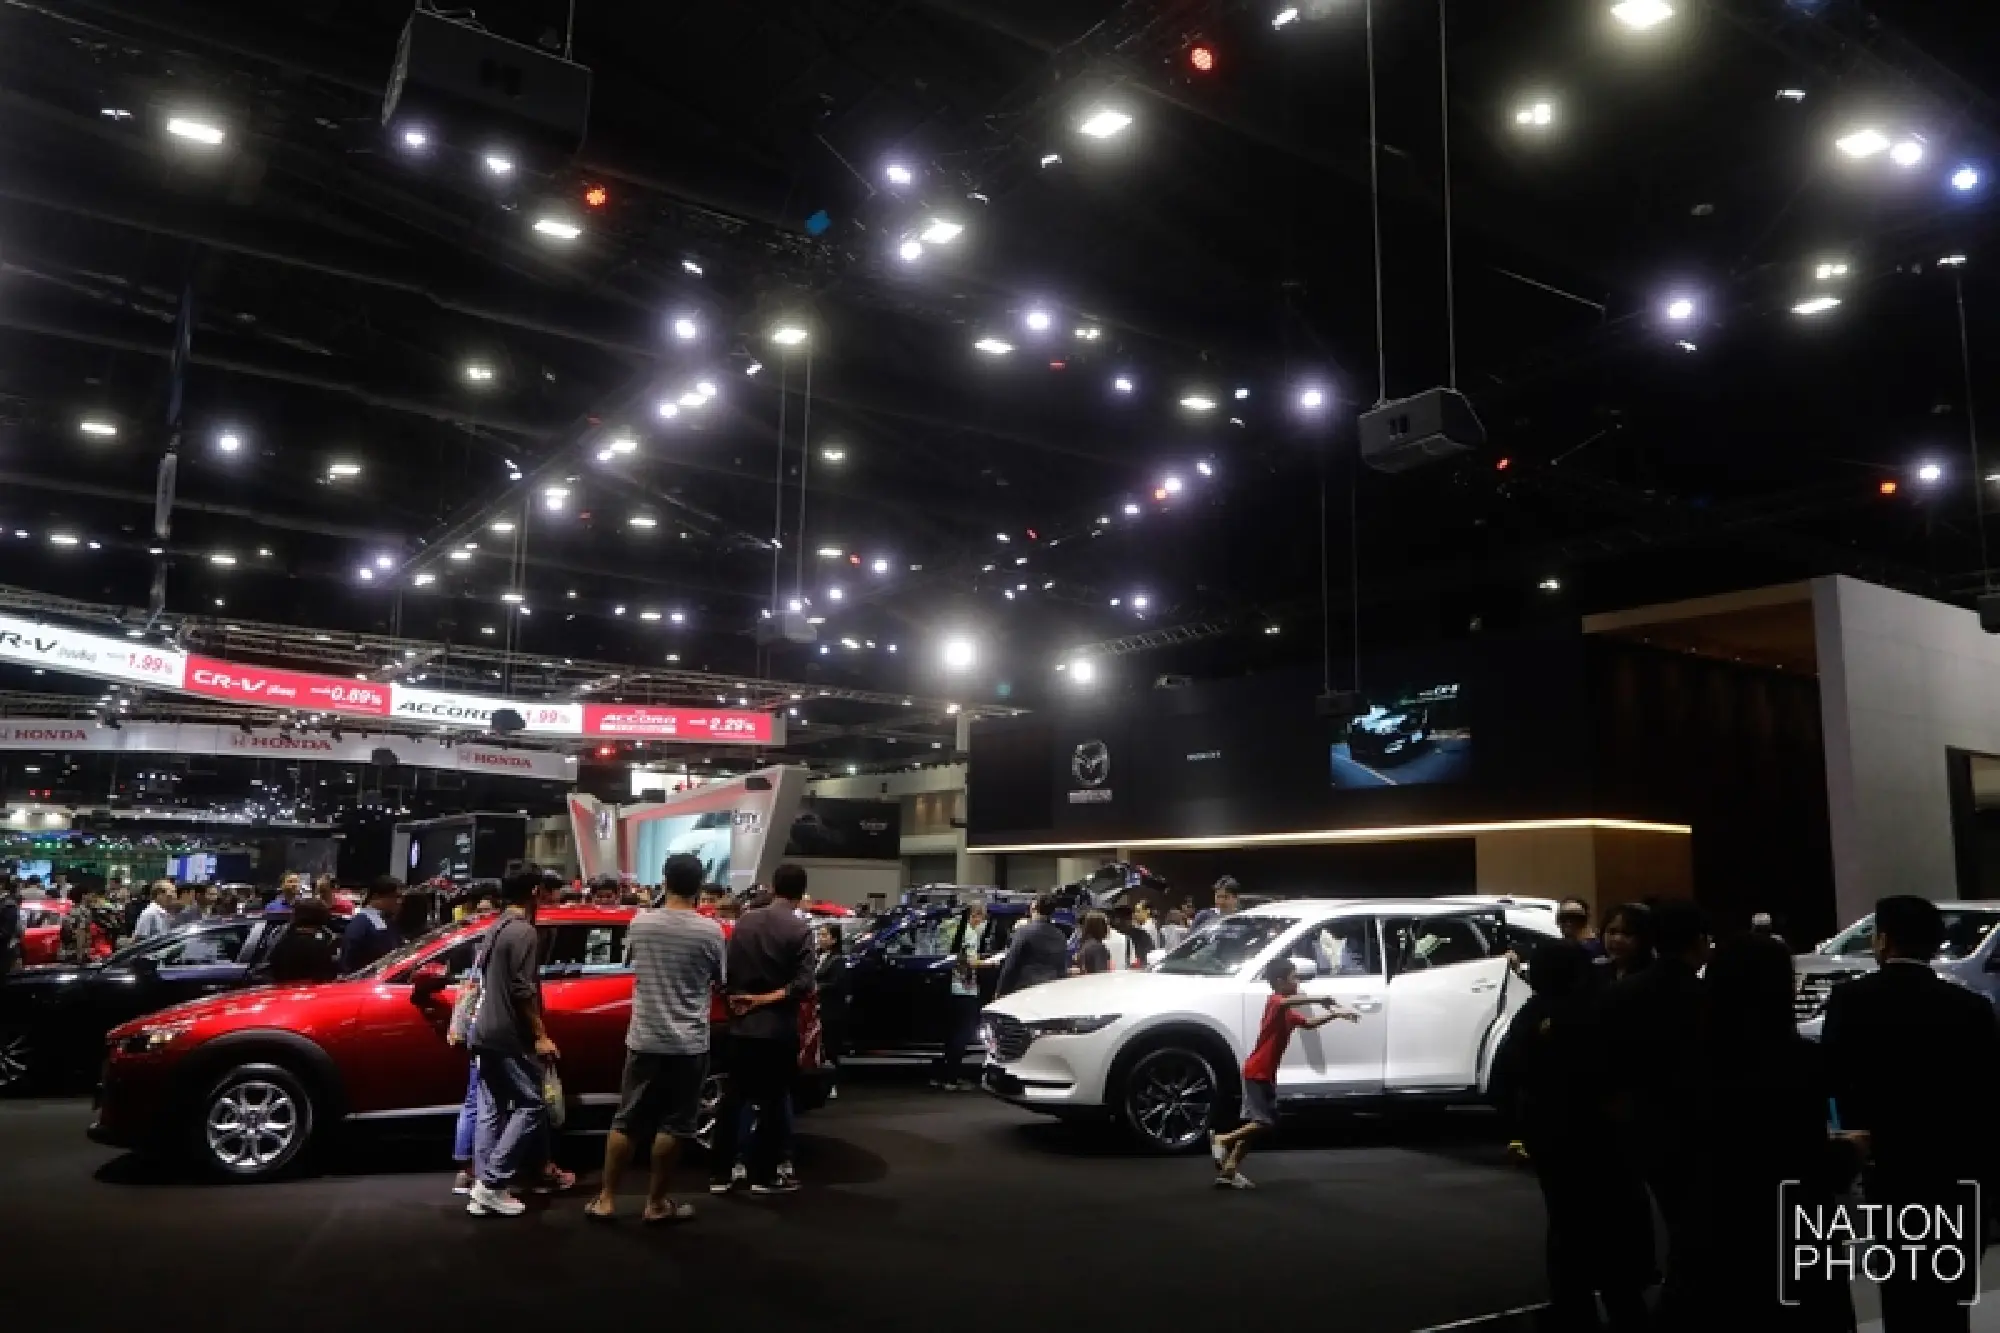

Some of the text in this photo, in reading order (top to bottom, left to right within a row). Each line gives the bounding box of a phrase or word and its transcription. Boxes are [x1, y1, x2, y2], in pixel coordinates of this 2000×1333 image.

[192, 669, 266, 692] CR-V
[14, 729, 88, 741] HONDA
[251, 736, 332, 751] HONDA
[474, 752, 533, 768] HONDA
